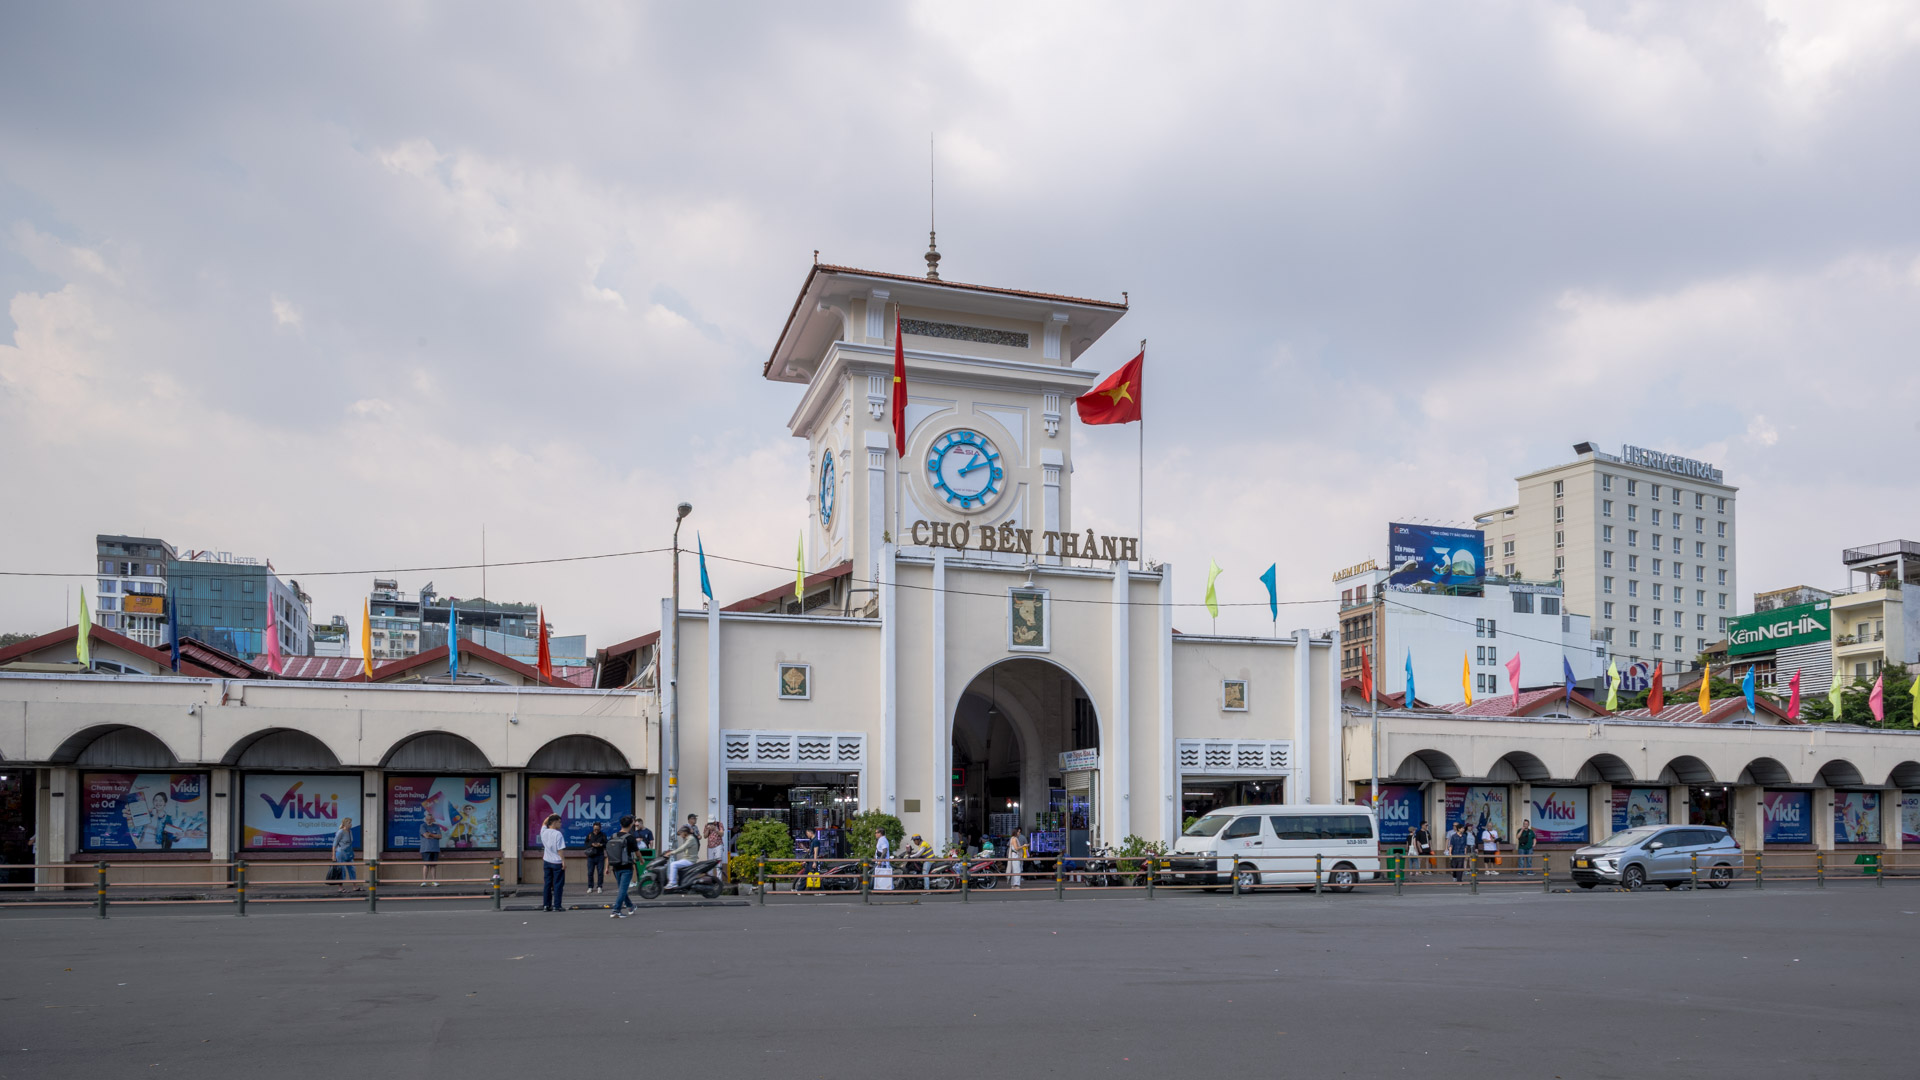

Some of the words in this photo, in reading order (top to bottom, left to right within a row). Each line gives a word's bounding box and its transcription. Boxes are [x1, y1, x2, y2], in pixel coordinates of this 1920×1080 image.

[959, 431, 975, 444] 12
[928, 459, 939, 471] 9
[1623, 444, 1667, 469] LIBERTY
[1668, 454, 1716, 481] CENTRAL
[992, 467, 1003, 479] 3
[961, 496, 971, 508] 6
[912, 519, 970, 551] CHỢ
[979, 519, 1033, 553] BẾN
[1042, 528, 1138, 561] THÀNH
[171, 779, 199, 794] Vikki
[465, 781, 490, 794] Vikki
[260, 781, 338, 819] Vikki
[542, 783, 612, 819] Vikki
[1482, 788, 1503, 802] Vikki
[1533, 792, 1575, 819] Vikki
[1763, 795, 1800, 821] Vikki
